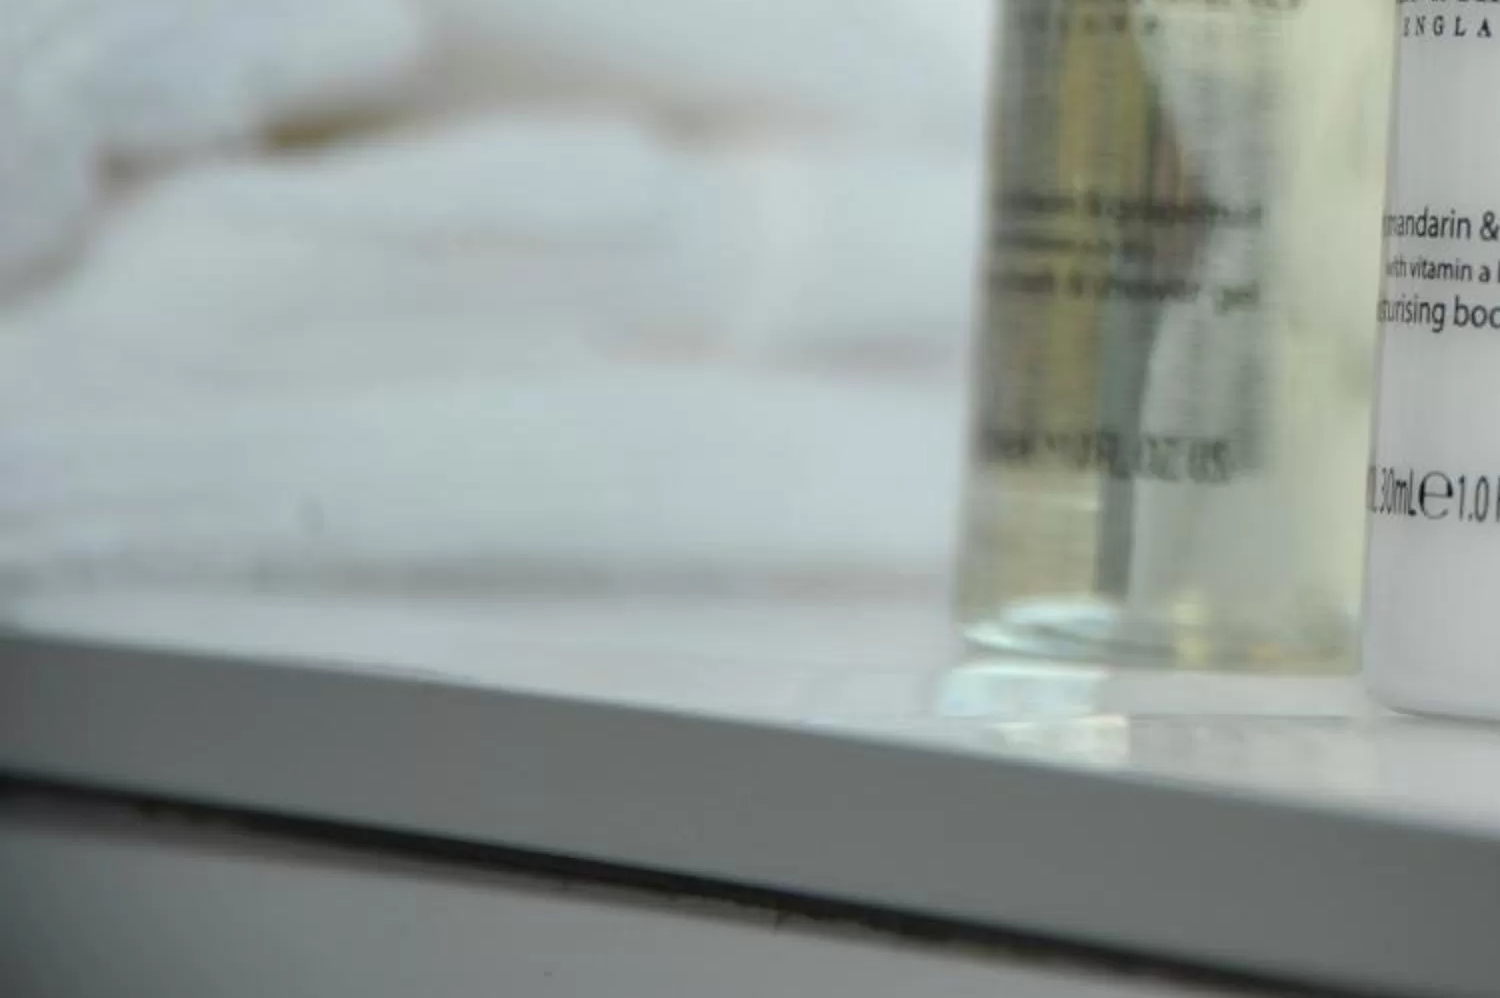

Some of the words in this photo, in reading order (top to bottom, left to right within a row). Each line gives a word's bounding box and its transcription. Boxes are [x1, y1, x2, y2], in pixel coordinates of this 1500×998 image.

[1480, 210, 1499, 242] &
[1409, 255, 1472, 284] vitamin
[1479, 266, 1490, 284] a
[1458, 474, 1490, 523] 1.0
